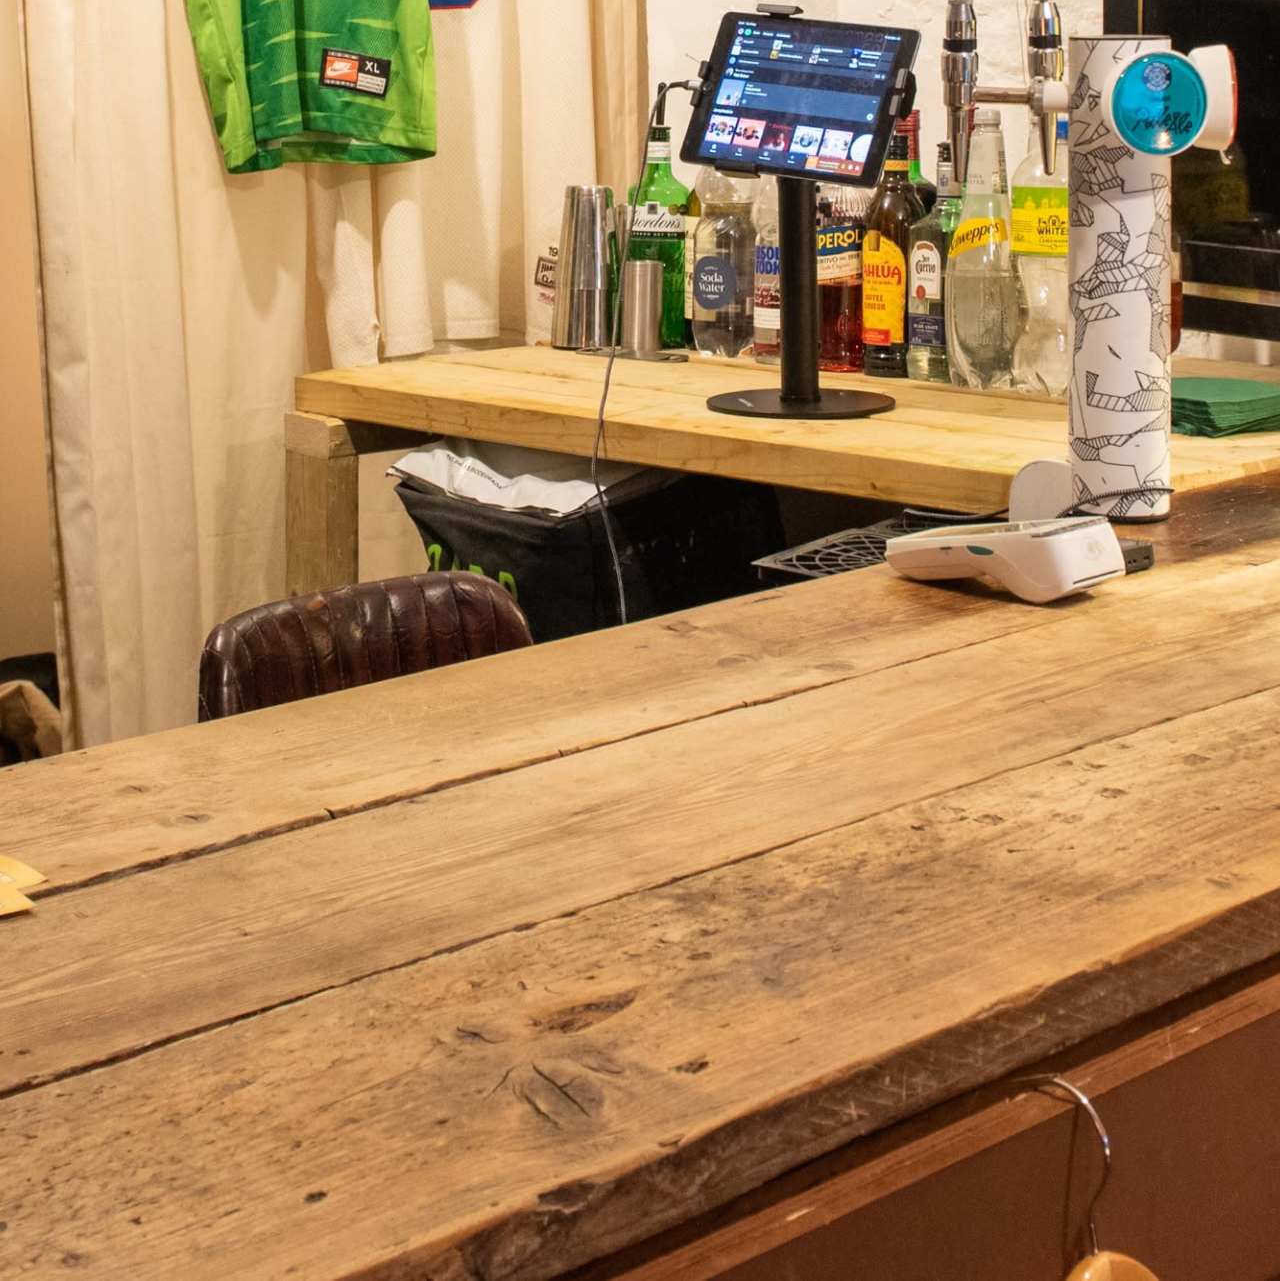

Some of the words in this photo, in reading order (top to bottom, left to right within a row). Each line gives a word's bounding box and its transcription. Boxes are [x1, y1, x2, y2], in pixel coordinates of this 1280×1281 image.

[365, 60, 380, 74] XL
[817, 230, 861, 250] PEROL
[700, 272, 724, 283] Soda
[698, 282, 725, 293] Water
